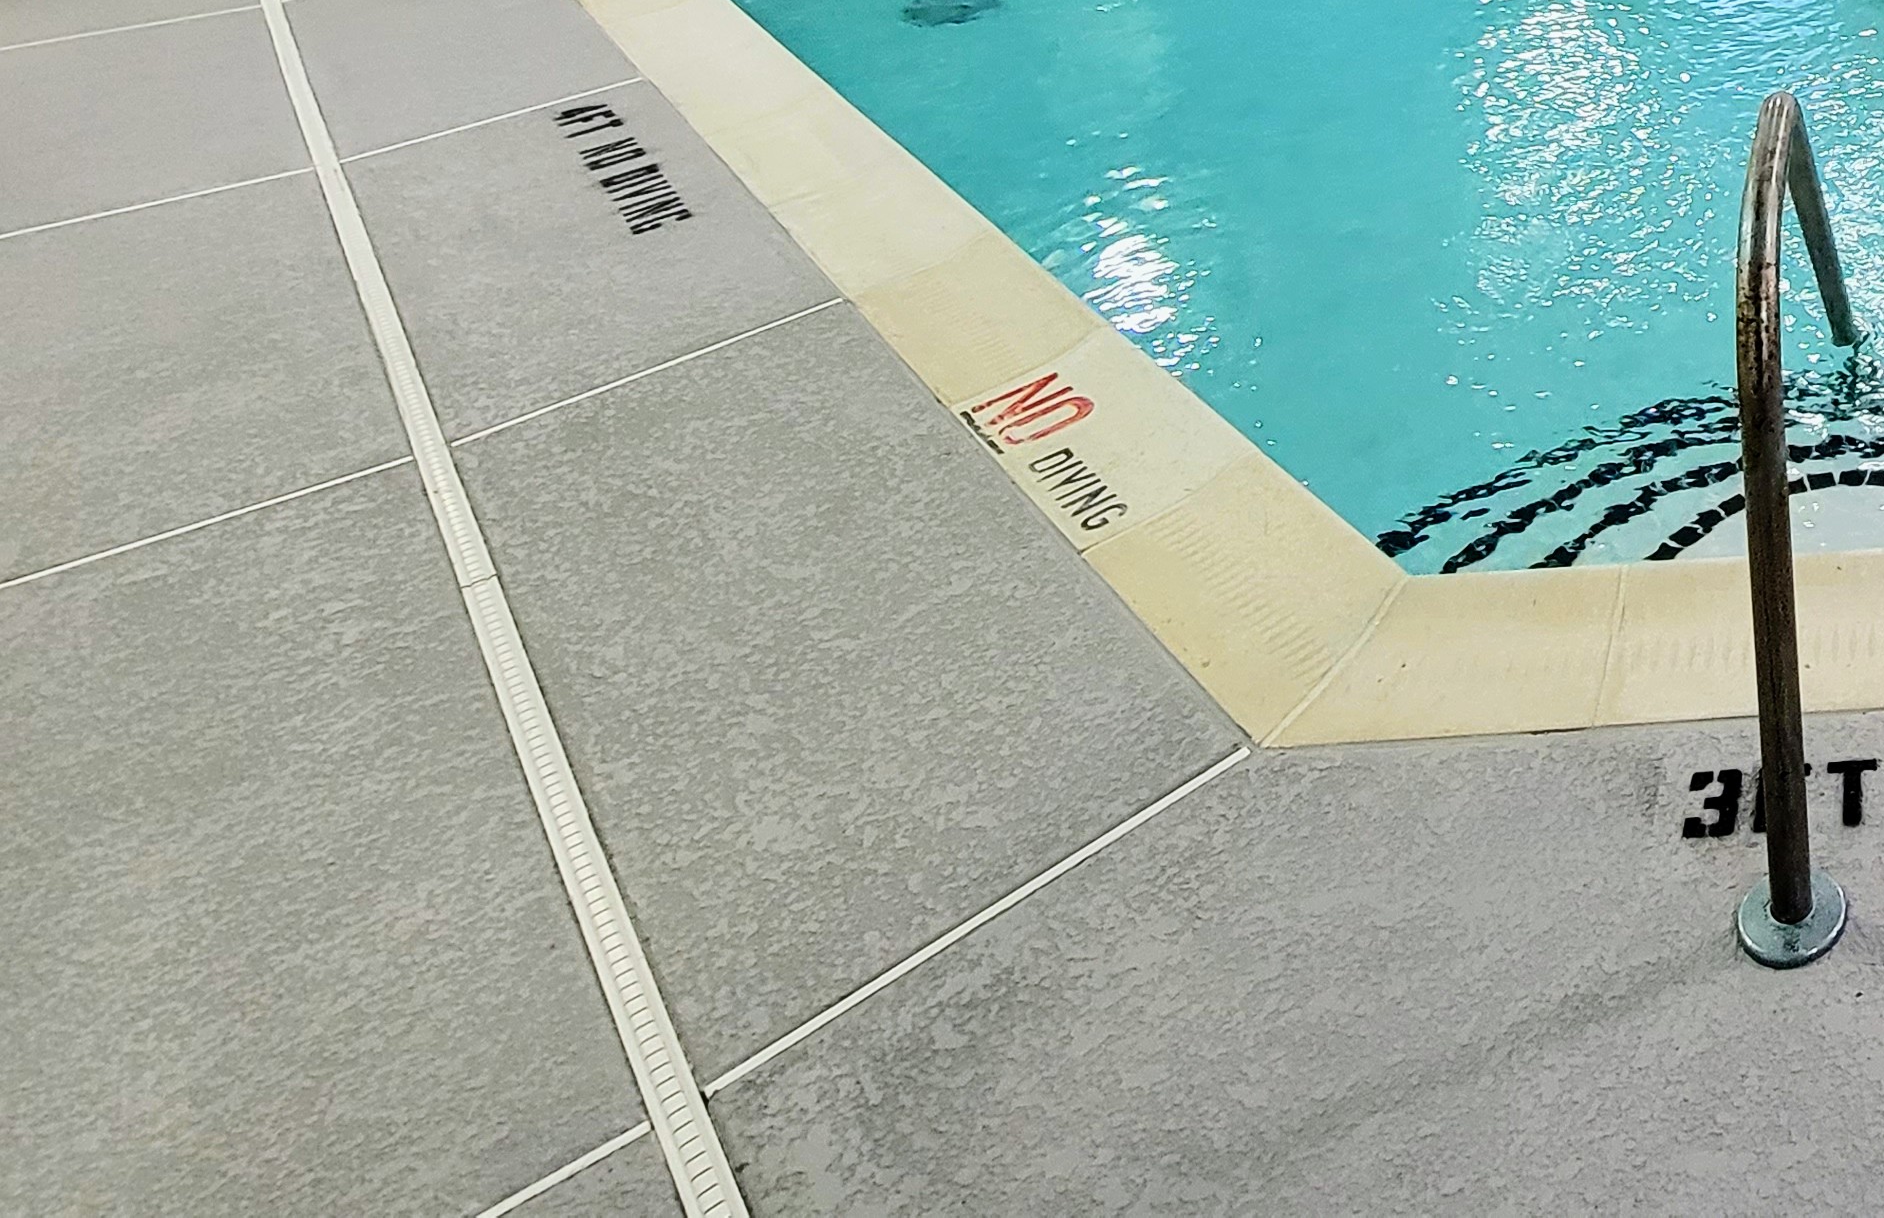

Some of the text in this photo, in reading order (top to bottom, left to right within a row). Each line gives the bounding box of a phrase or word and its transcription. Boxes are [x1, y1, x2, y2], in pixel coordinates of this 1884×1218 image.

[553, 104, 693, 236] 4FT NO DIVING
[971, 372, 1096, 445] NO
[1028, 447, 1129, 532] DIVING
